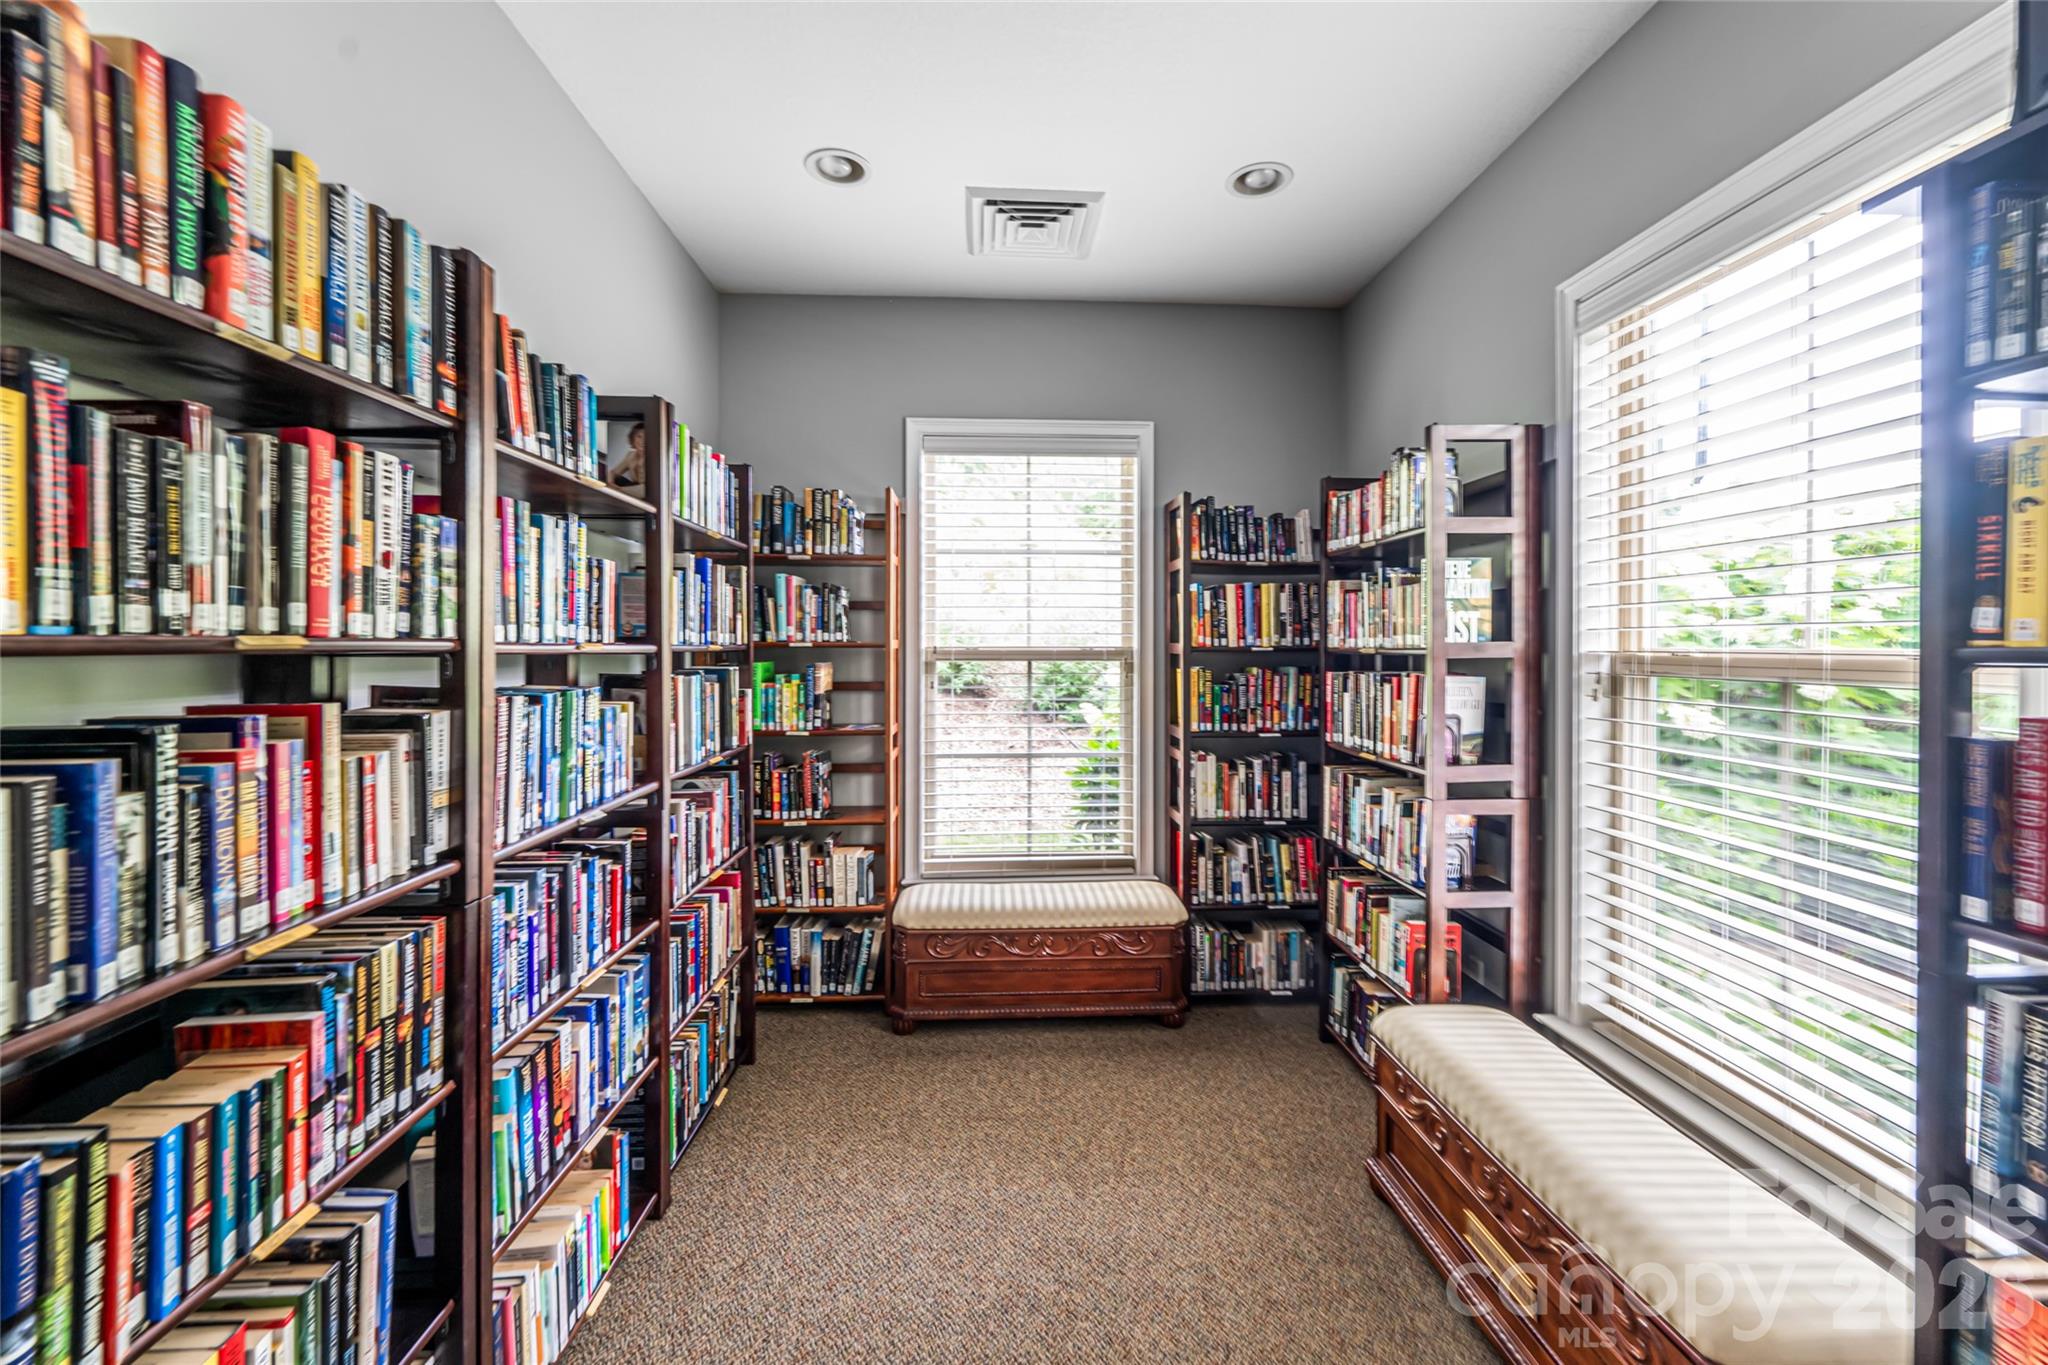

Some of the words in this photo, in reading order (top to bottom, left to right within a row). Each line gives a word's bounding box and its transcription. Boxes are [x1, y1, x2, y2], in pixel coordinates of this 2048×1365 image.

[176, 101, 197, 196] MARGARET
[329, 194, 348, 239] DAVID
[176, 195, 197, 272] ATWOOD
[377, 228, 393, 275] DAVID
[329, 237, 348, 306] BALDACCI
[377, 271, 393, 340] BALDACCI
[444, 270, 456, 312] DAVID
[444, 312, 457, 385] BALDACCI
[127, 477, 146, 515] DAVID
[127, 516, 147, 574] BALDACCI
[1975, 515, 2003, 581] SIXKILL
[167, 563, 183, 589] DAVID
[2017, 553, 2036, 572] AND
[2017, 576, 2036, 595] DAY
[157, 733, 179, 781] DALE
[2014, 722, 2047, 766] ROSES
[2014, 767, 2047, 797] ARE
[156, 783, 179, 854] BROWN
[215, 786, 235, 821] DAN
[2013, 797, 2047, 827] RED
[187, 808, 202, 839] DAN
[187, 840, 202, 889] BROWN
[215, 826, 236, 887] BROWN
[405, 943, 415, 973] JAMES
[422, 937, 433, 962] JAMES
[357, 966, 367, 997] JAMES
[371, 956, 380, 984] JAMES
[405, 972, 415, 988] LEE
[422, 963, 433, 977] LEE
[357, 997, 367, 1014] LEE
[371, 984, 380, 1000] LEE
[405, 988, 415, 1015] BURKE
[422, 978, 433, 1003] BURKE
[357, 1014, 367, 1044] BURKE
[371, 1001, 380, 1028] BURKE
[1985, 1000, 2005, 1032] JAMES
[383, 1018, 395, 1049] JAMES
[2023, 1013, 2048, 1060] JAMES
[383, 1050, 395, 1070] LEE
[2021, 1060, 2048, 1150] PATTERSON
[19, 1188, 39, 1242] GREAT
[18, 1242, 39, 1311] DIVIDE
